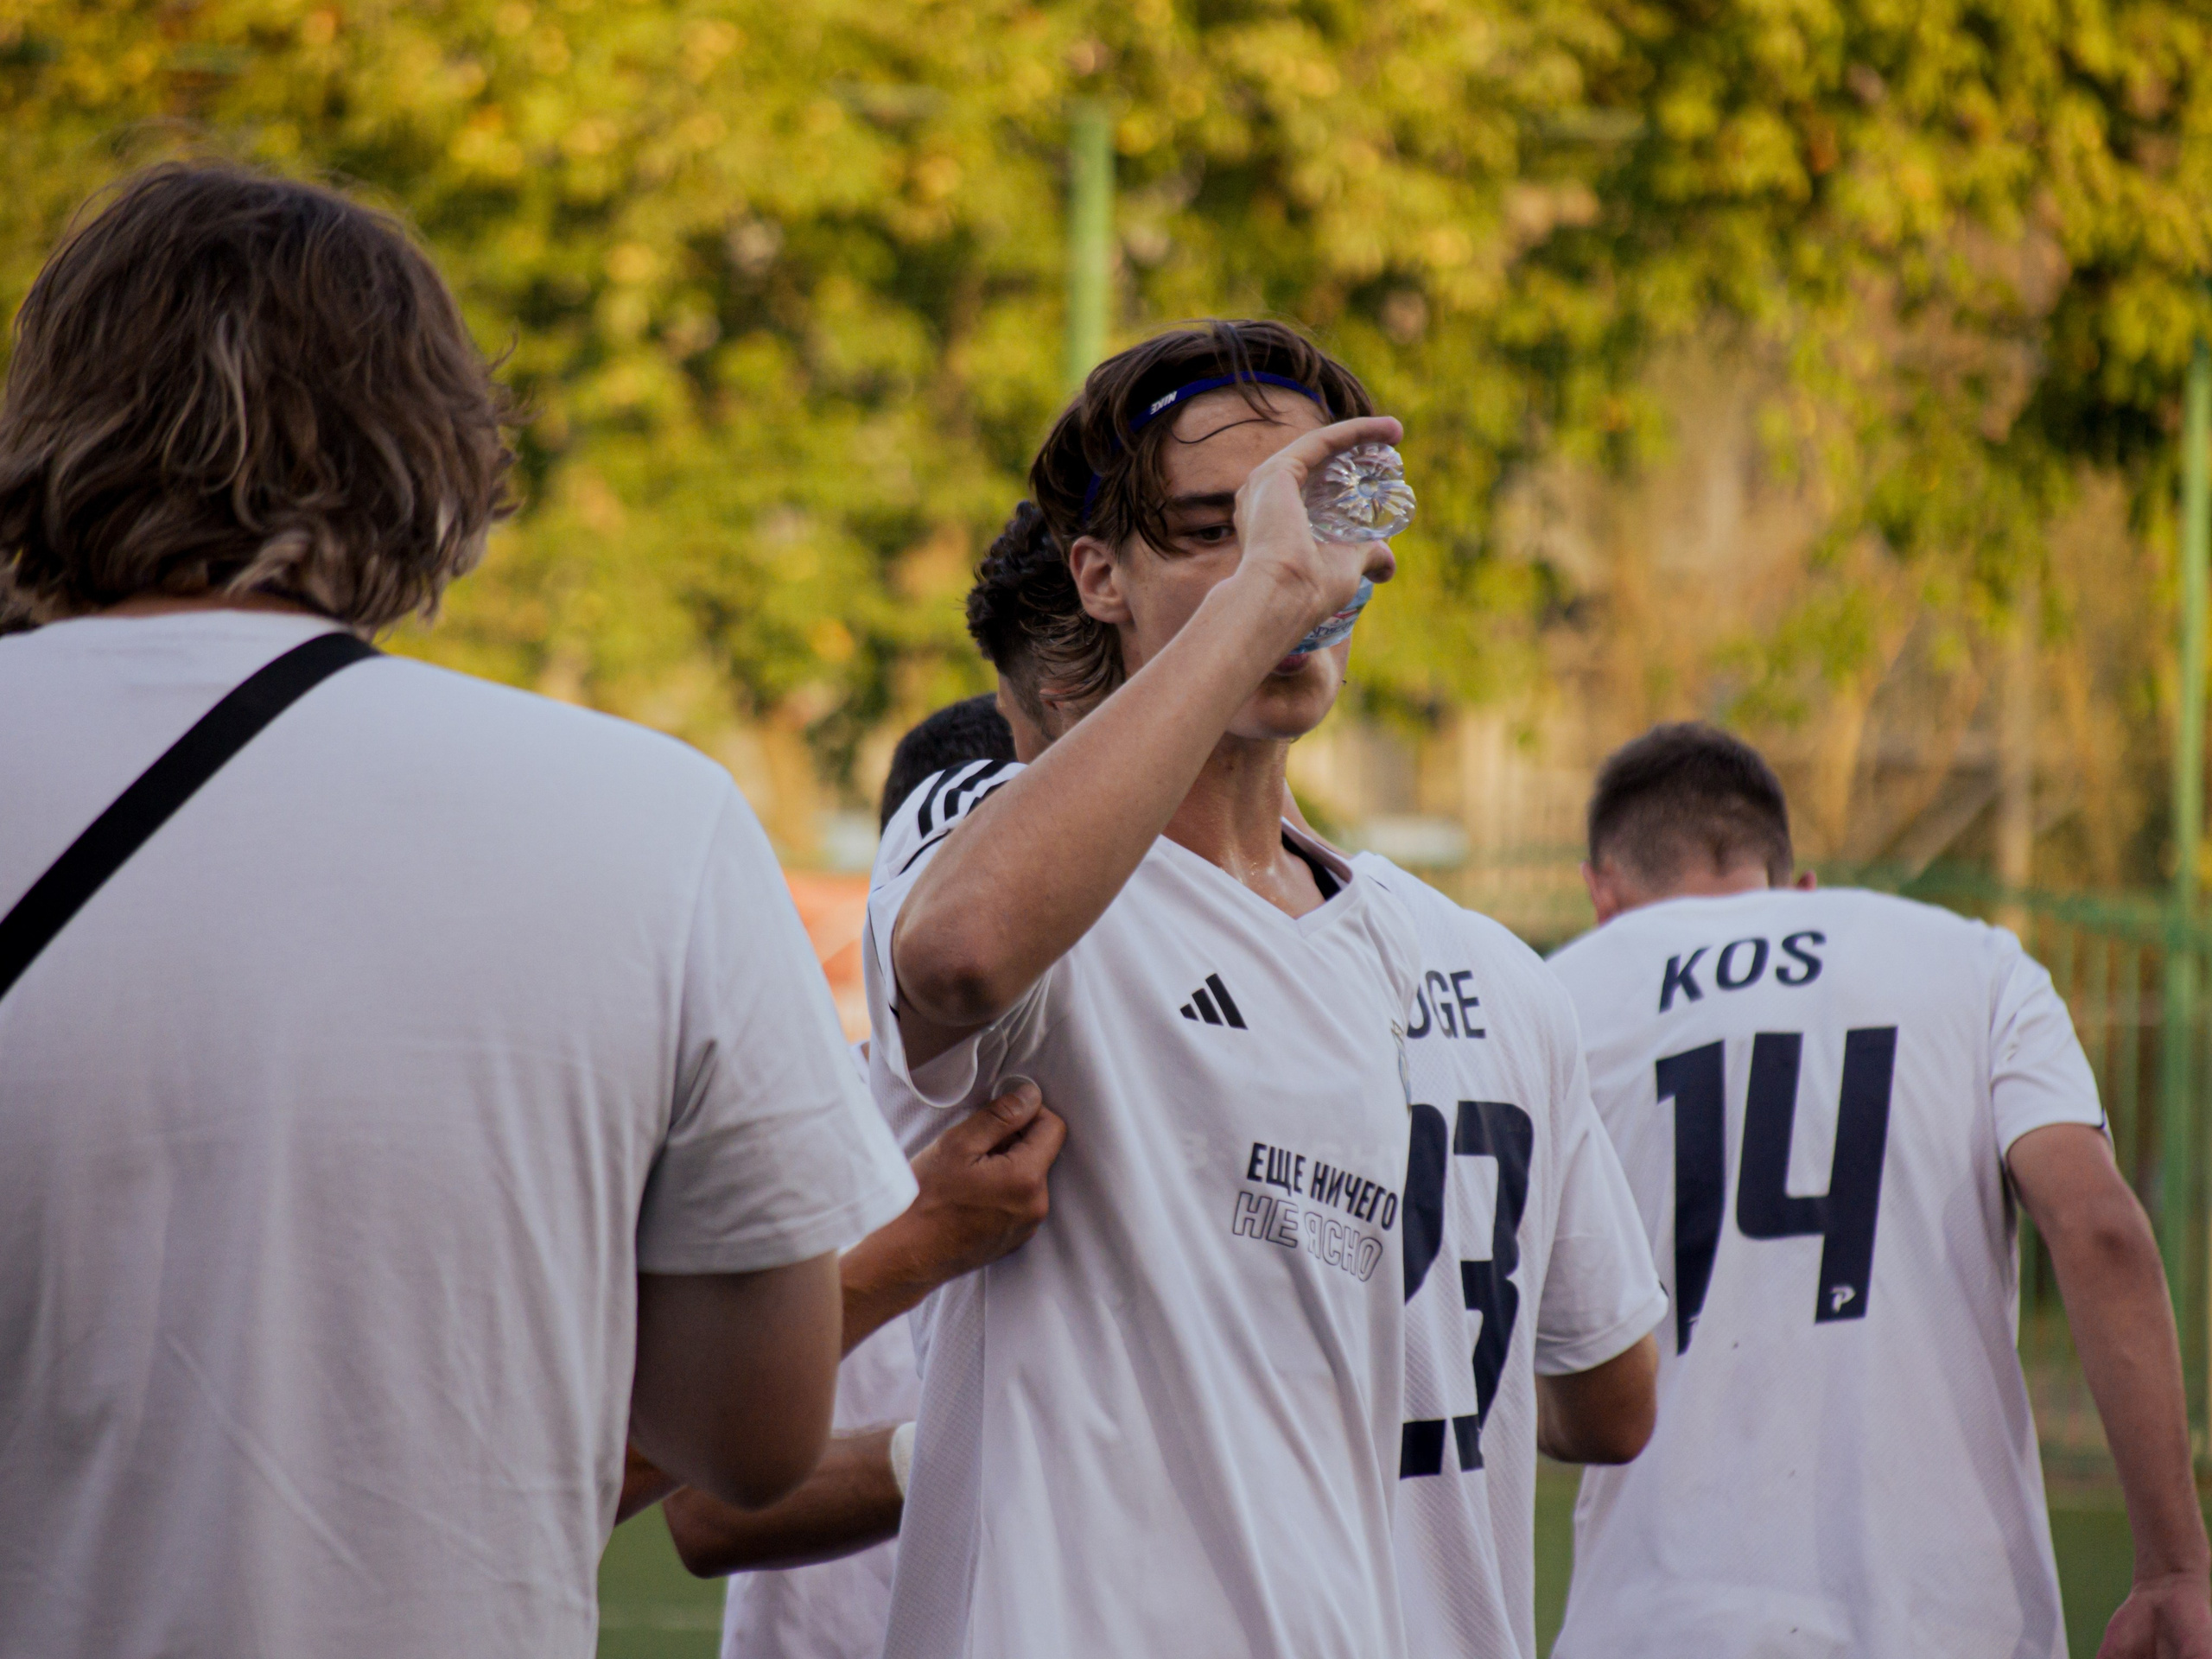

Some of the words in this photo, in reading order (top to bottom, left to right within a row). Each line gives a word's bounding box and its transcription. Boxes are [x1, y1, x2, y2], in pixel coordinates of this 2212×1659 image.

[1151, 391, 1178, 415] NIKE
[1659, 931, 1827, 1014] KOS
[1247, 1142, 1306, 1196] ЕЩЕ
[1311, 1162, 1398, 1230] НИЧЕГО
[1656, 1026, 1898, 1355] 14
[1233, 1192, 1299, 1248] НЕ
[1305, 1212, 1382, 1281] ЯСНО
